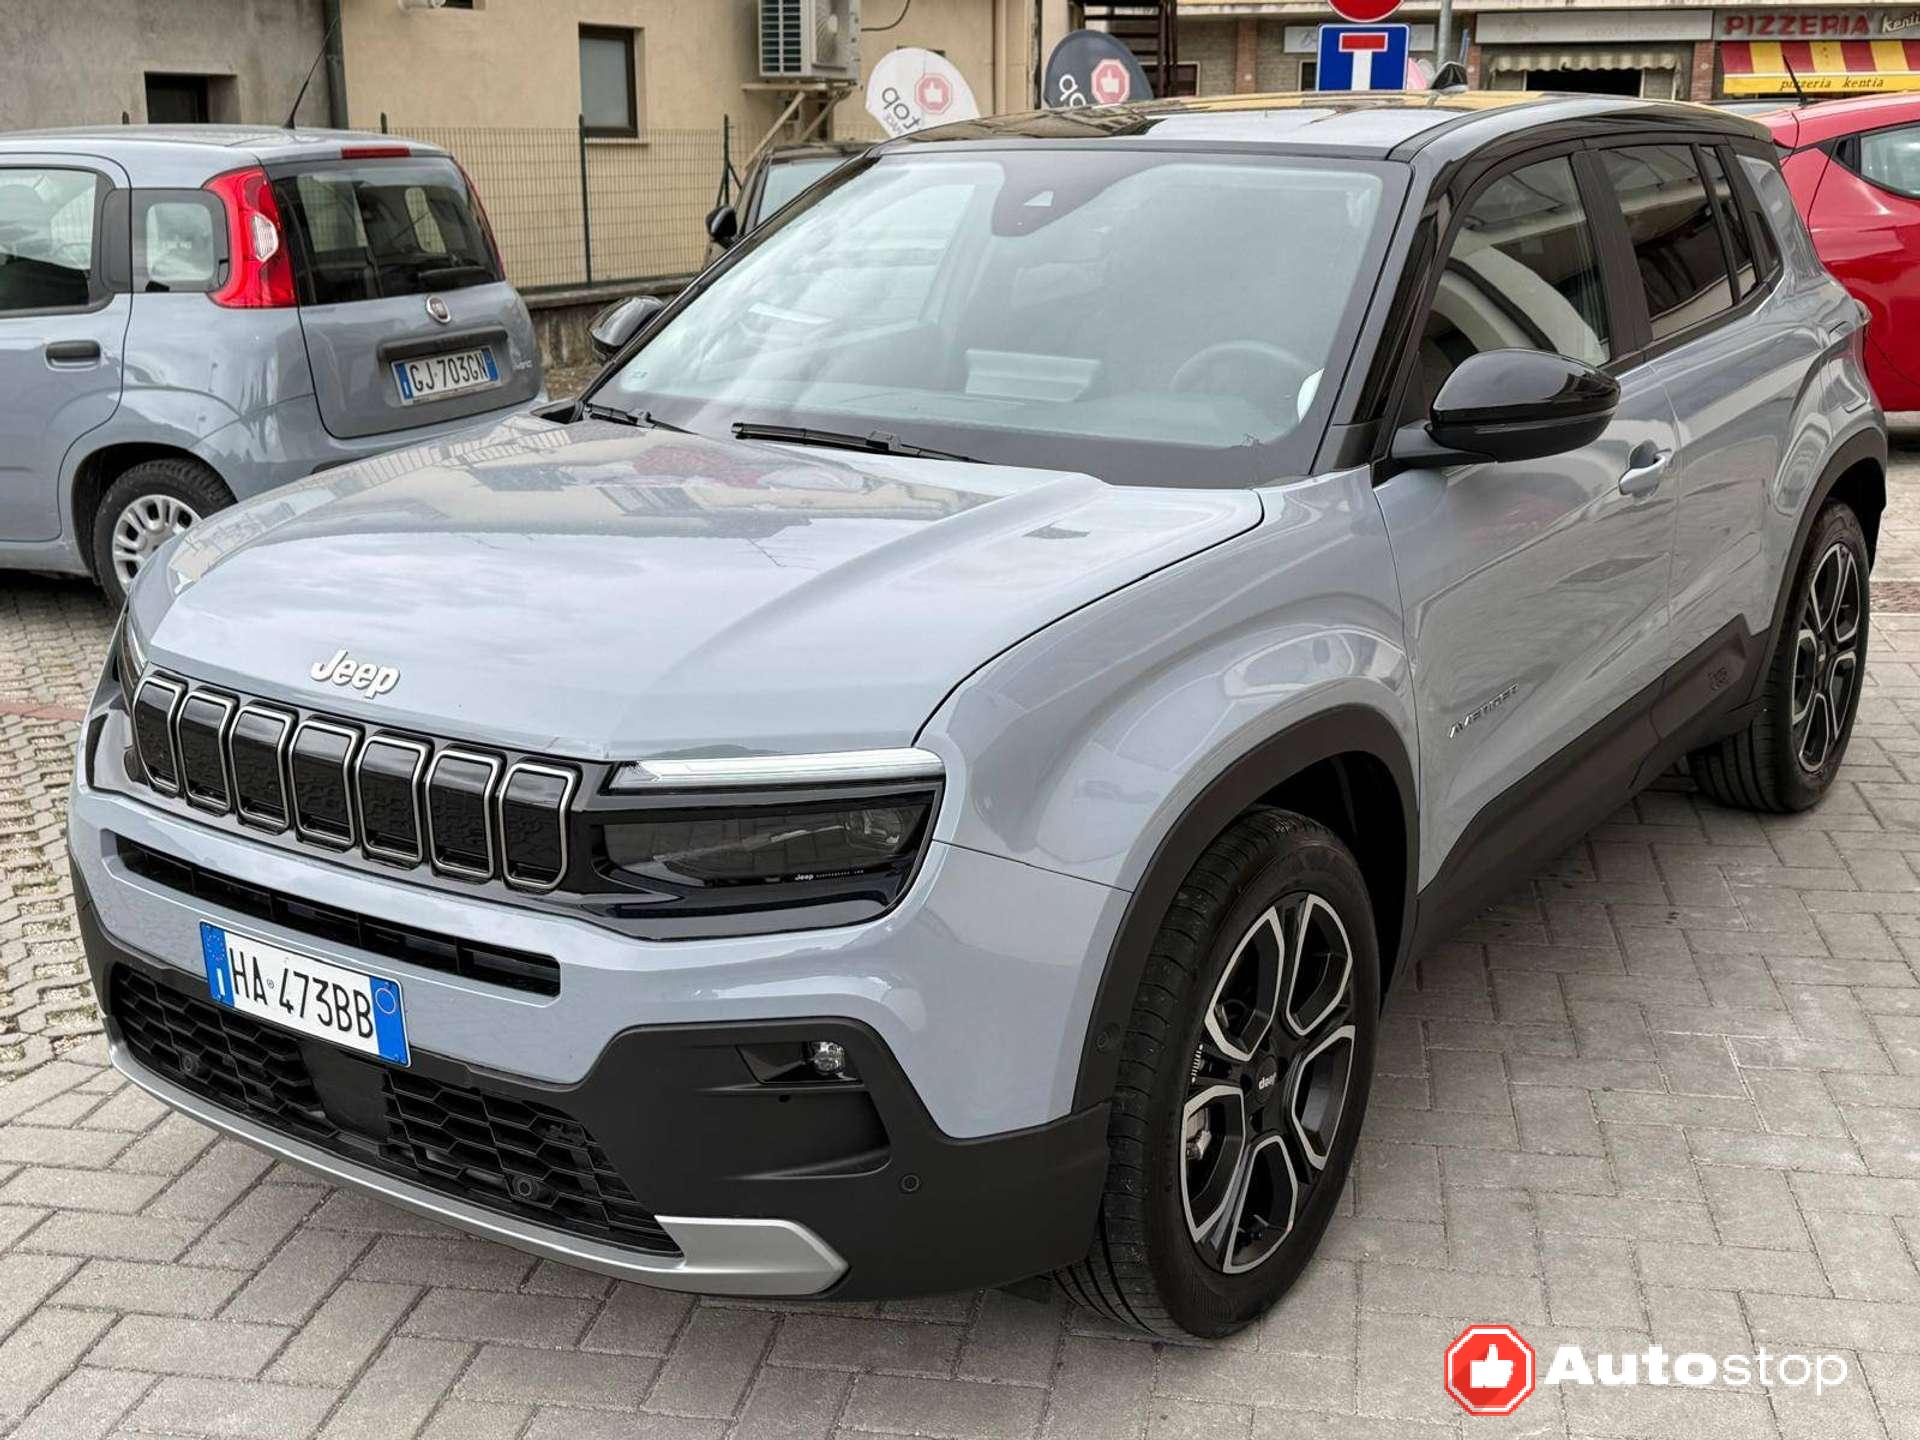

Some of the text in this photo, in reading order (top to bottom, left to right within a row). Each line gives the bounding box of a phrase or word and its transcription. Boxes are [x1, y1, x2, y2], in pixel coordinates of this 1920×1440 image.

[1724, 11, 1920, 35] PIZZERIA kenti
[1842, 76, 1884, 89] kentia
[310, 648, 401, 701] Jeep
